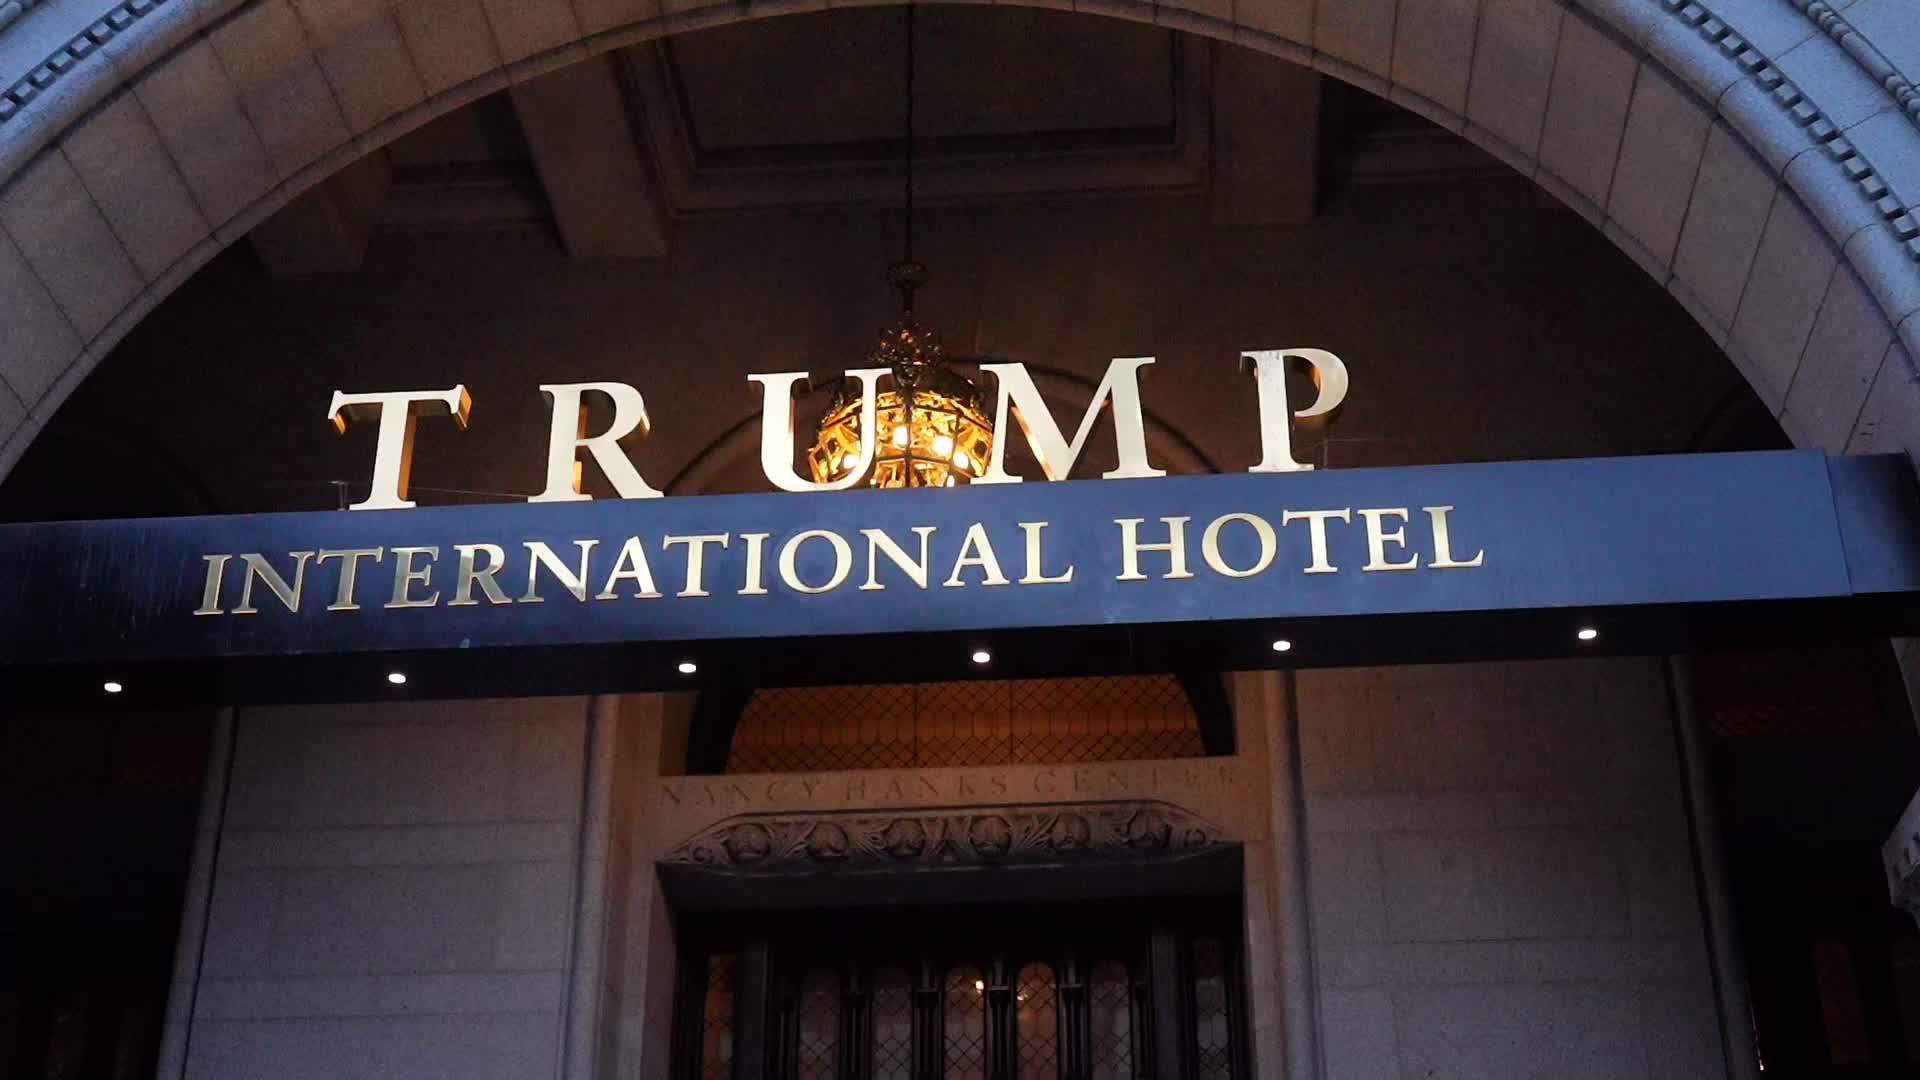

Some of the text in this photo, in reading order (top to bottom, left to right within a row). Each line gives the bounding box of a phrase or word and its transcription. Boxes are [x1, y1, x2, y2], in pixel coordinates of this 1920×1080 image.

[326, 347, 1350, 512] TRUMP
[193, 505, 1485, 616] INTERNATIONAL HOTEL
[660, 778, 822, 805] NANCY
[844, 772, 1008, 802] HANKS
